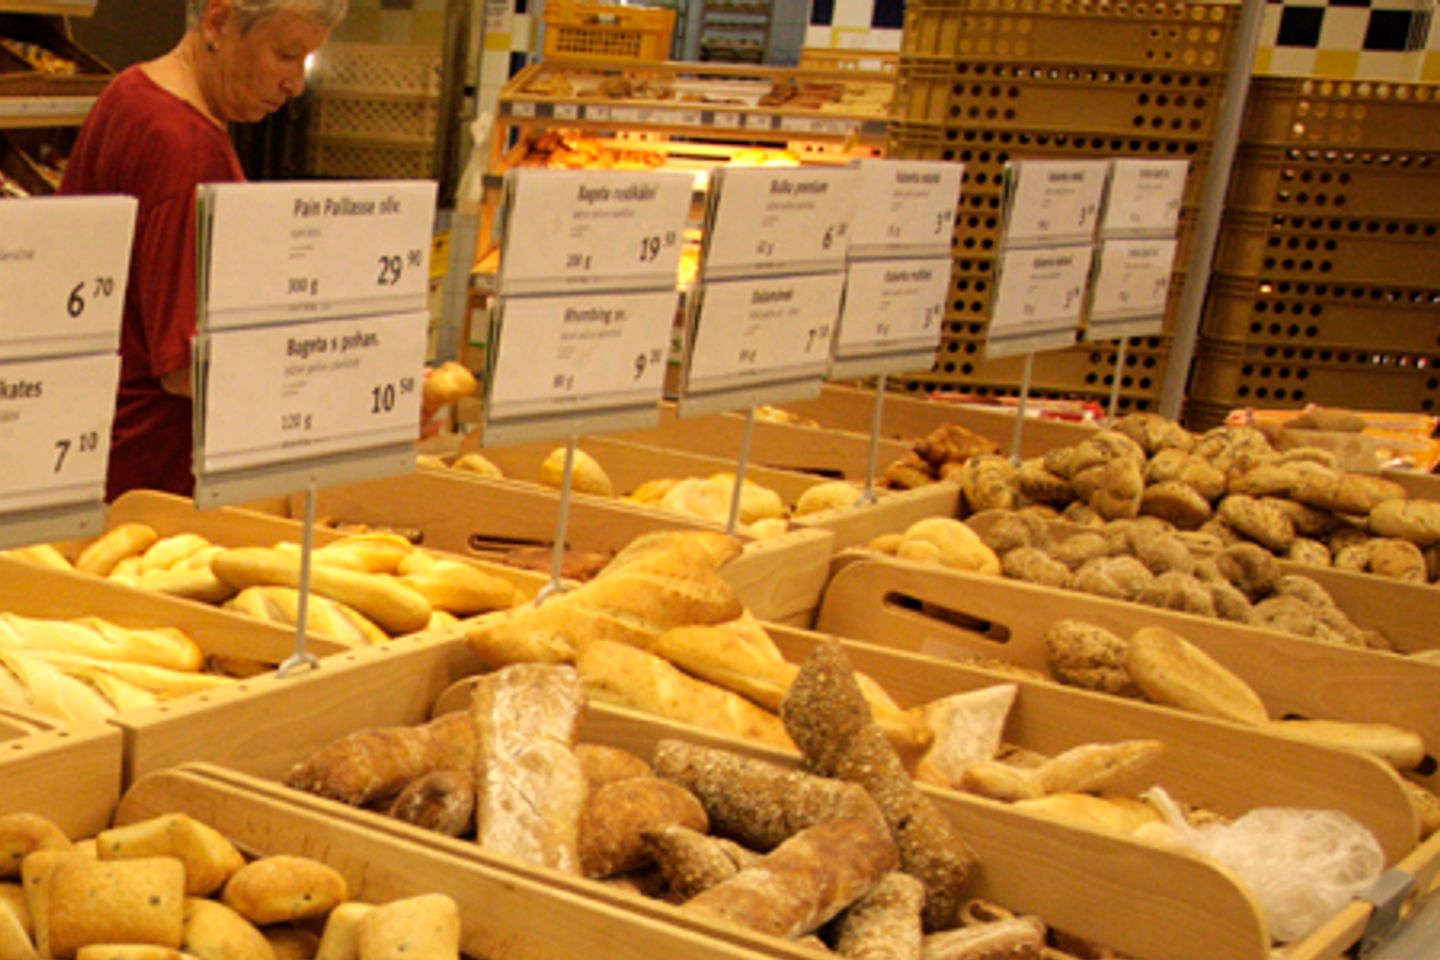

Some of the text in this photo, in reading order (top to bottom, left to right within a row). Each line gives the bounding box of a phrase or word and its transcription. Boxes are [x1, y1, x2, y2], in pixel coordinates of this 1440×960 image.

[293, 197, 321, 219] Pain
[639, 236, 662, 264] 19
[376, 254, 404, 286] 29
[66, 276, 114, 318] 6 70
[370, 384, 396, 416] 10
[52, 431, 99, 475] 7 10
